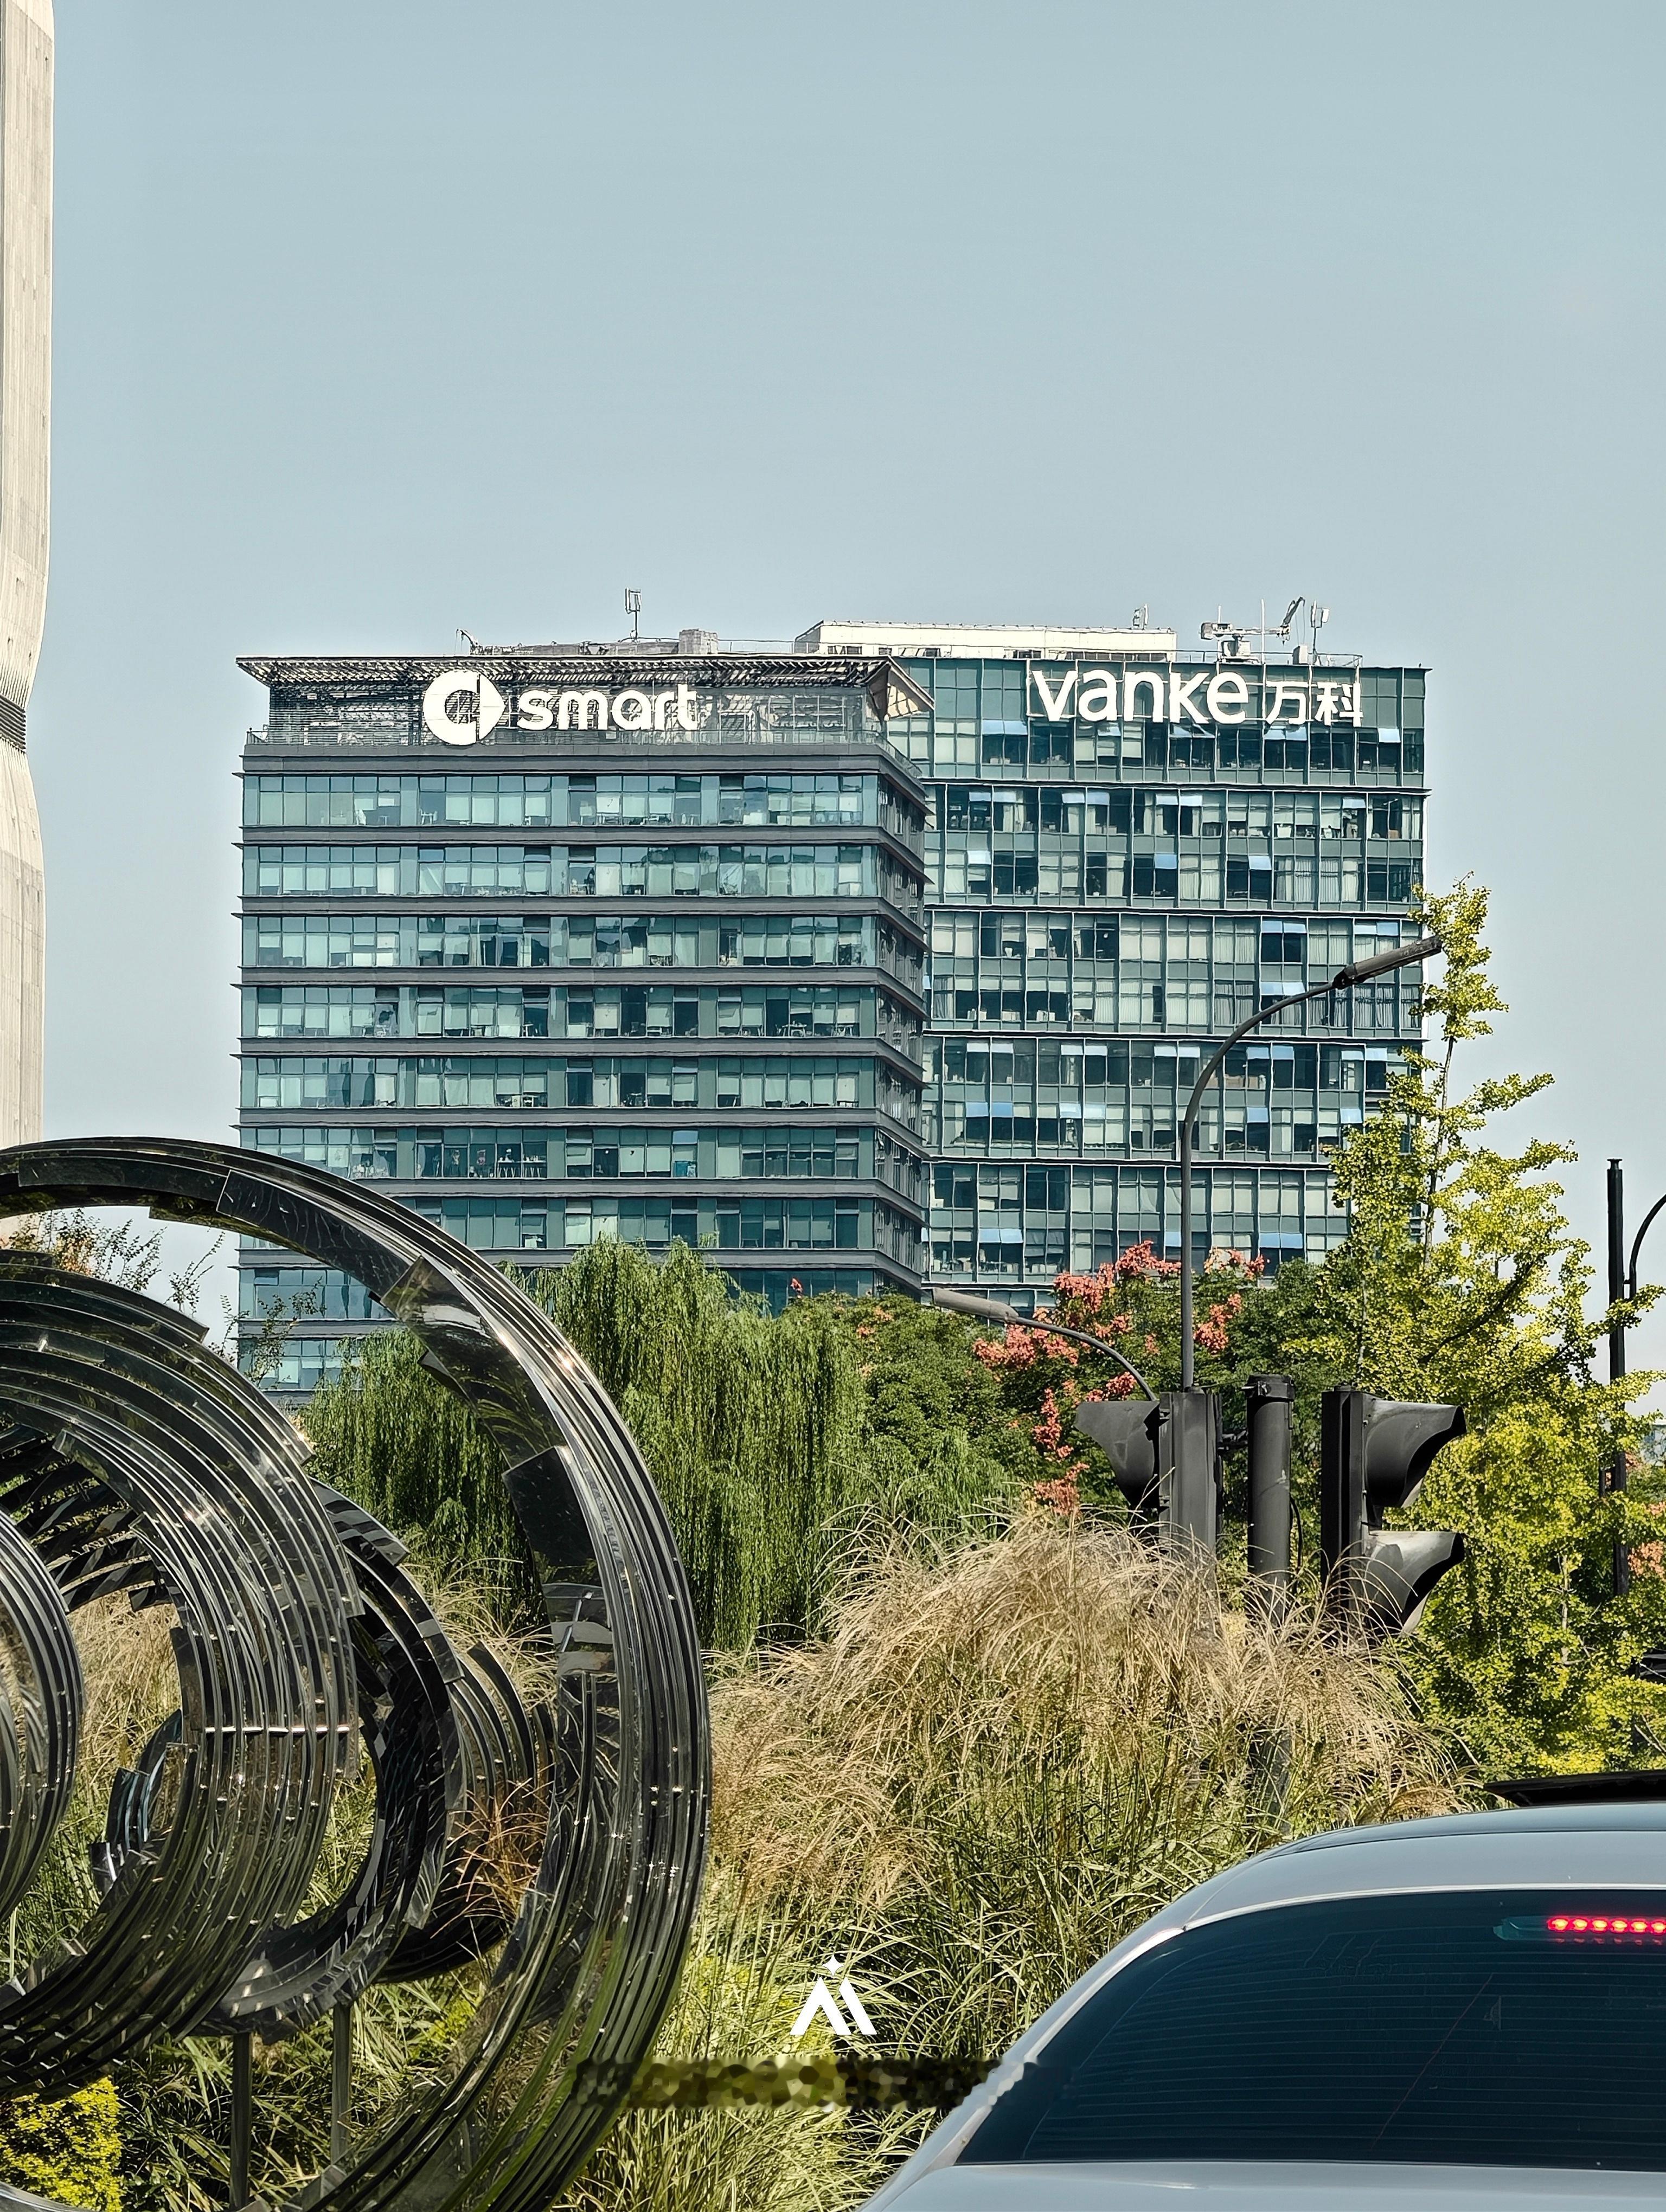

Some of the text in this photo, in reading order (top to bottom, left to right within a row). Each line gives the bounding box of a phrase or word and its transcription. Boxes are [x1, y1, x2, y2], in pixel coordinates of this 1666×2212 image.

[517, 684, 698, 730] smart
[1031, 669, 1364, 727] vanke 万科
